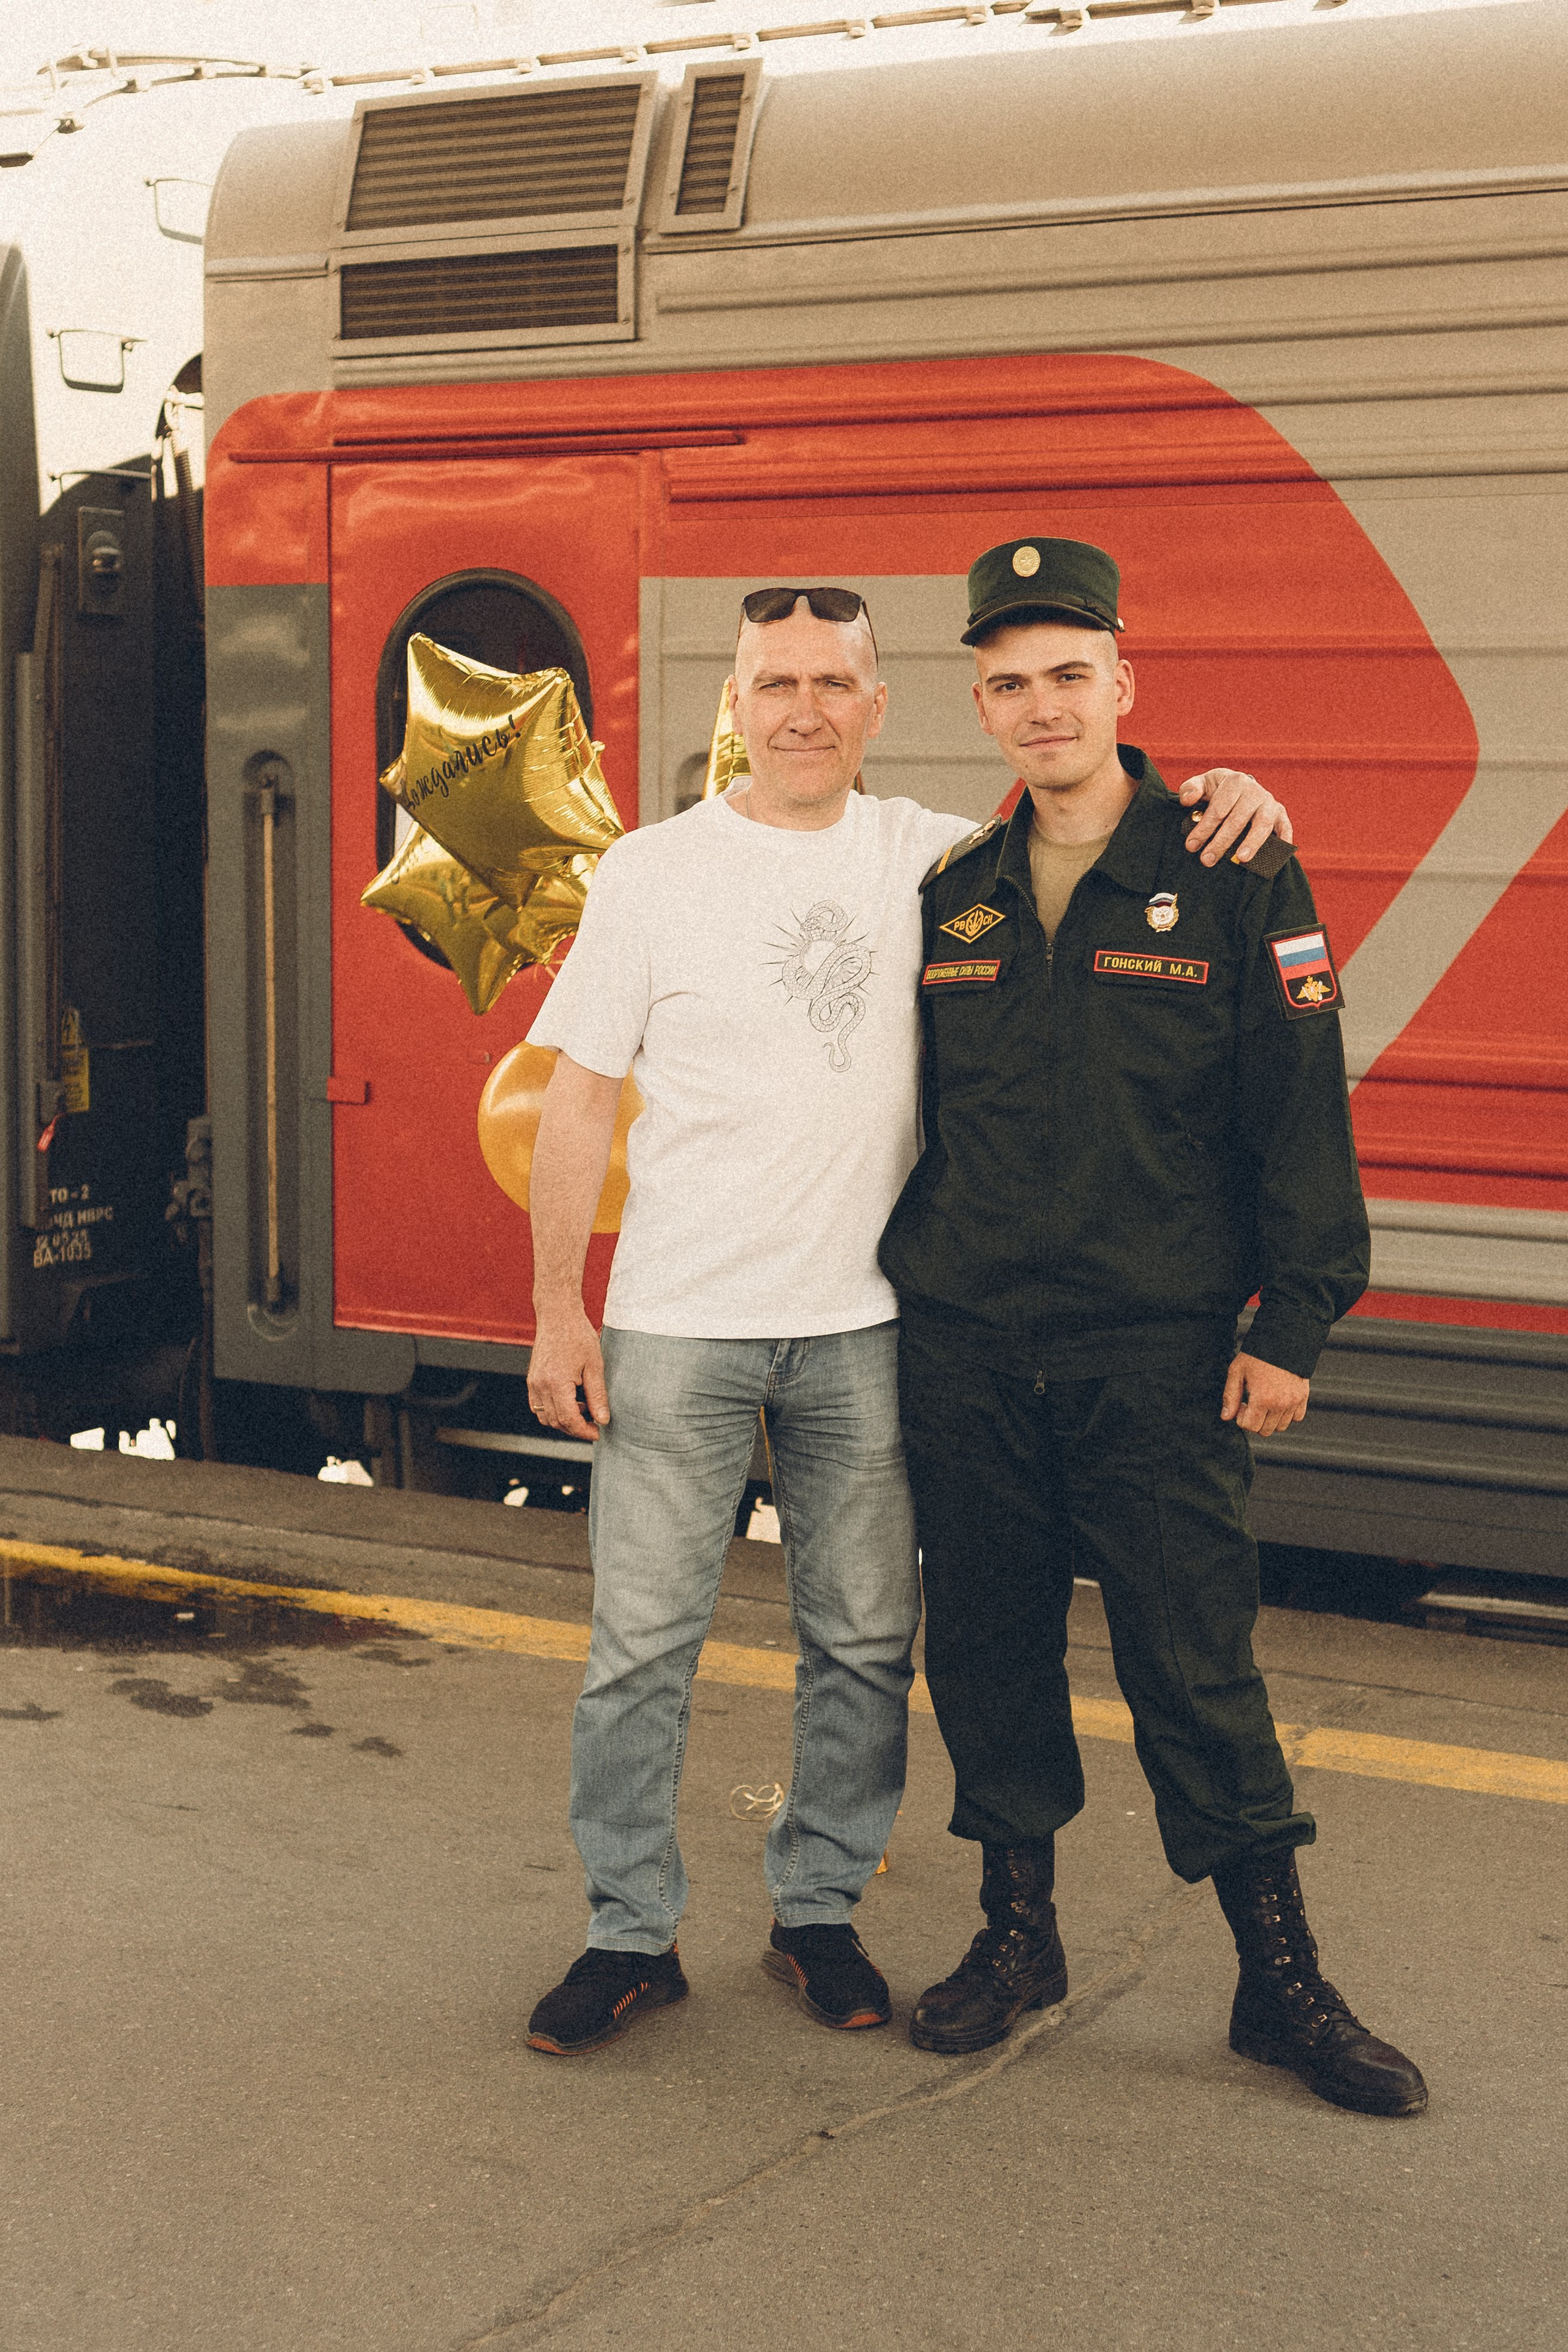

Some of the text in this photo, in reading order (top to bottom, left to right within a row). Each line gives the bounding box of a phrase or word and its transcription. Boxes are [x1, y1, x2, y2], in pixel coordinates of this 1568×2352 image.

[959, 965, 974, 976] СИЛЫ
[973, 965, 997, 975] РОССИИ
[1104, 957, 1198, 978] ГОНСКИЙ М.А.
